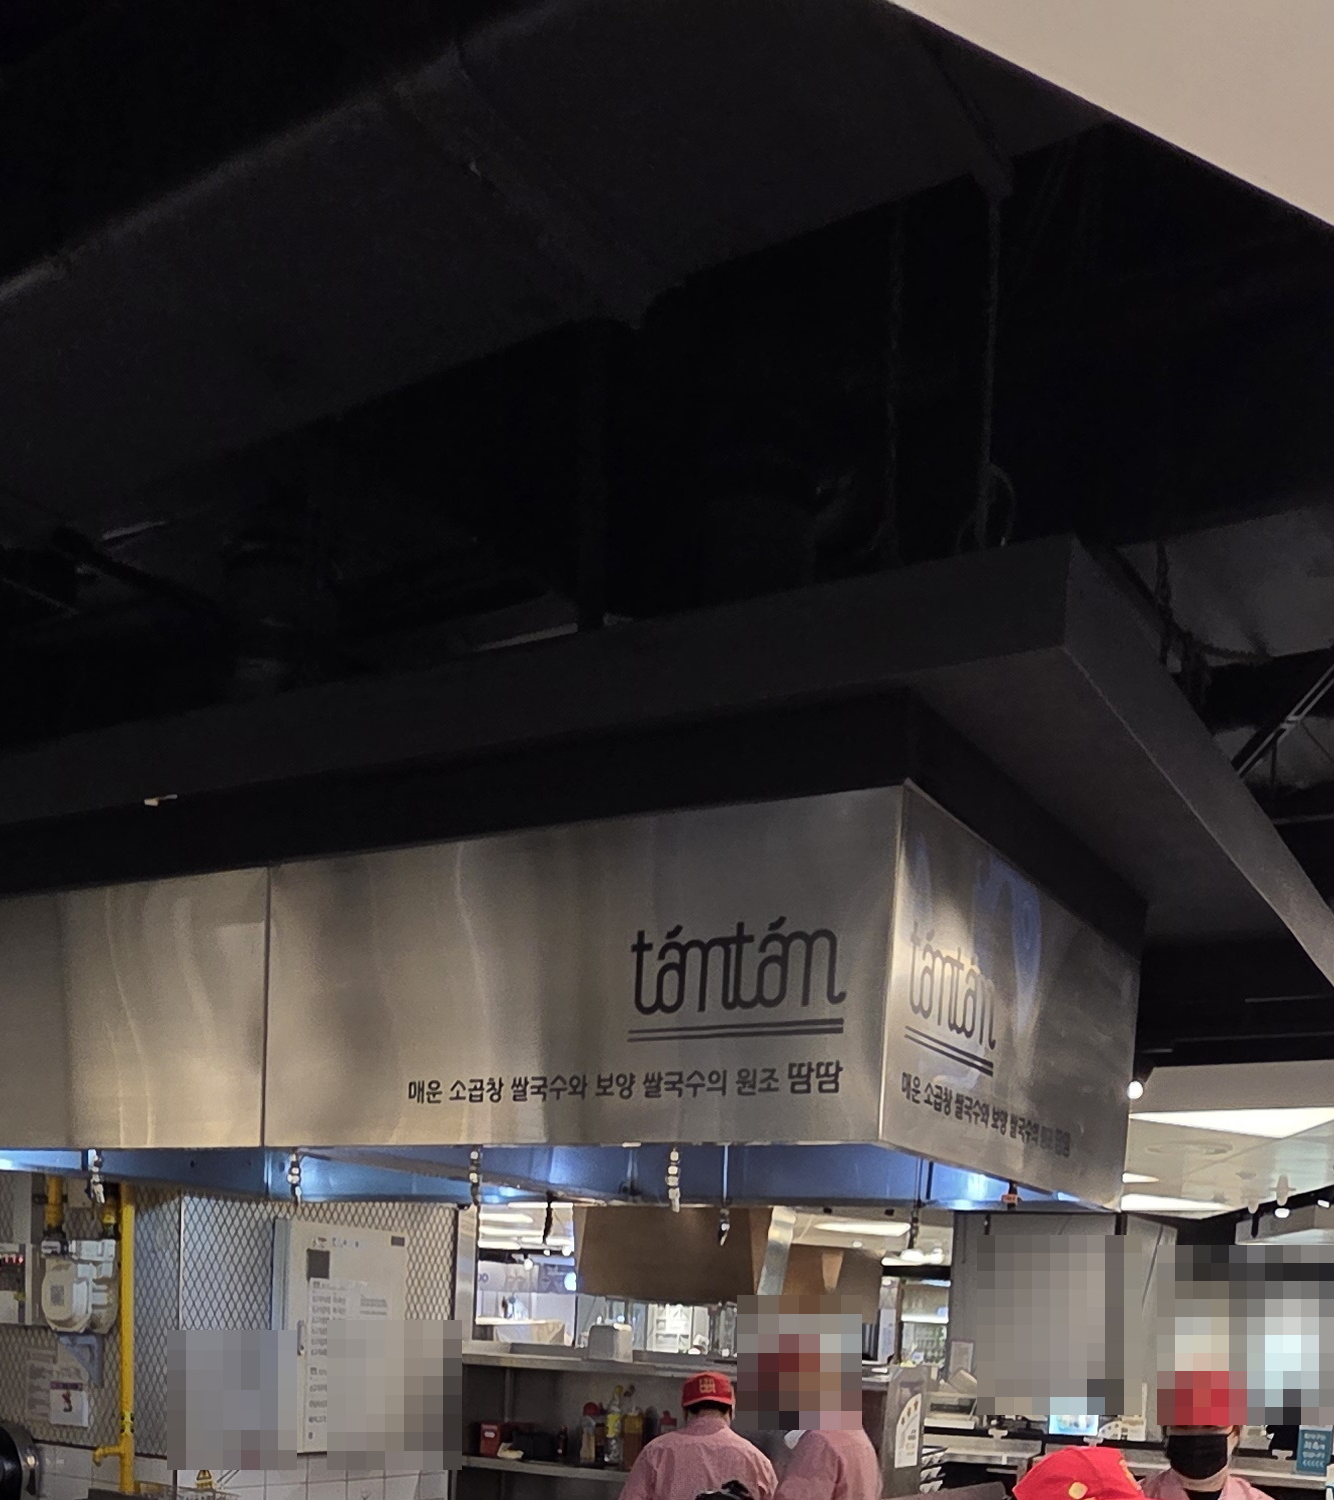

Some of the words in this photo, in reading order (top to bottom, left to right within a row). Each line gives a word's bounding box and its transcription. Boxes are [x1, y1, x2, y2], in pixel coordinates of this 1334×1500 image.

[408, 1080, 442, 1104] 매운
[449, 1077, 504, 1104] 소곱창
[511, 1073, 588, 1103] 쌀국수와
[595, 1072, 637, 1101] 보양
[642, 1068, 727, 1099] 쌀국수의
[735, 1067, 780, 1097] 원조
[787, 1060, 844, 1095] 땀땀
[902, 1071, 921, 1104] 매운
